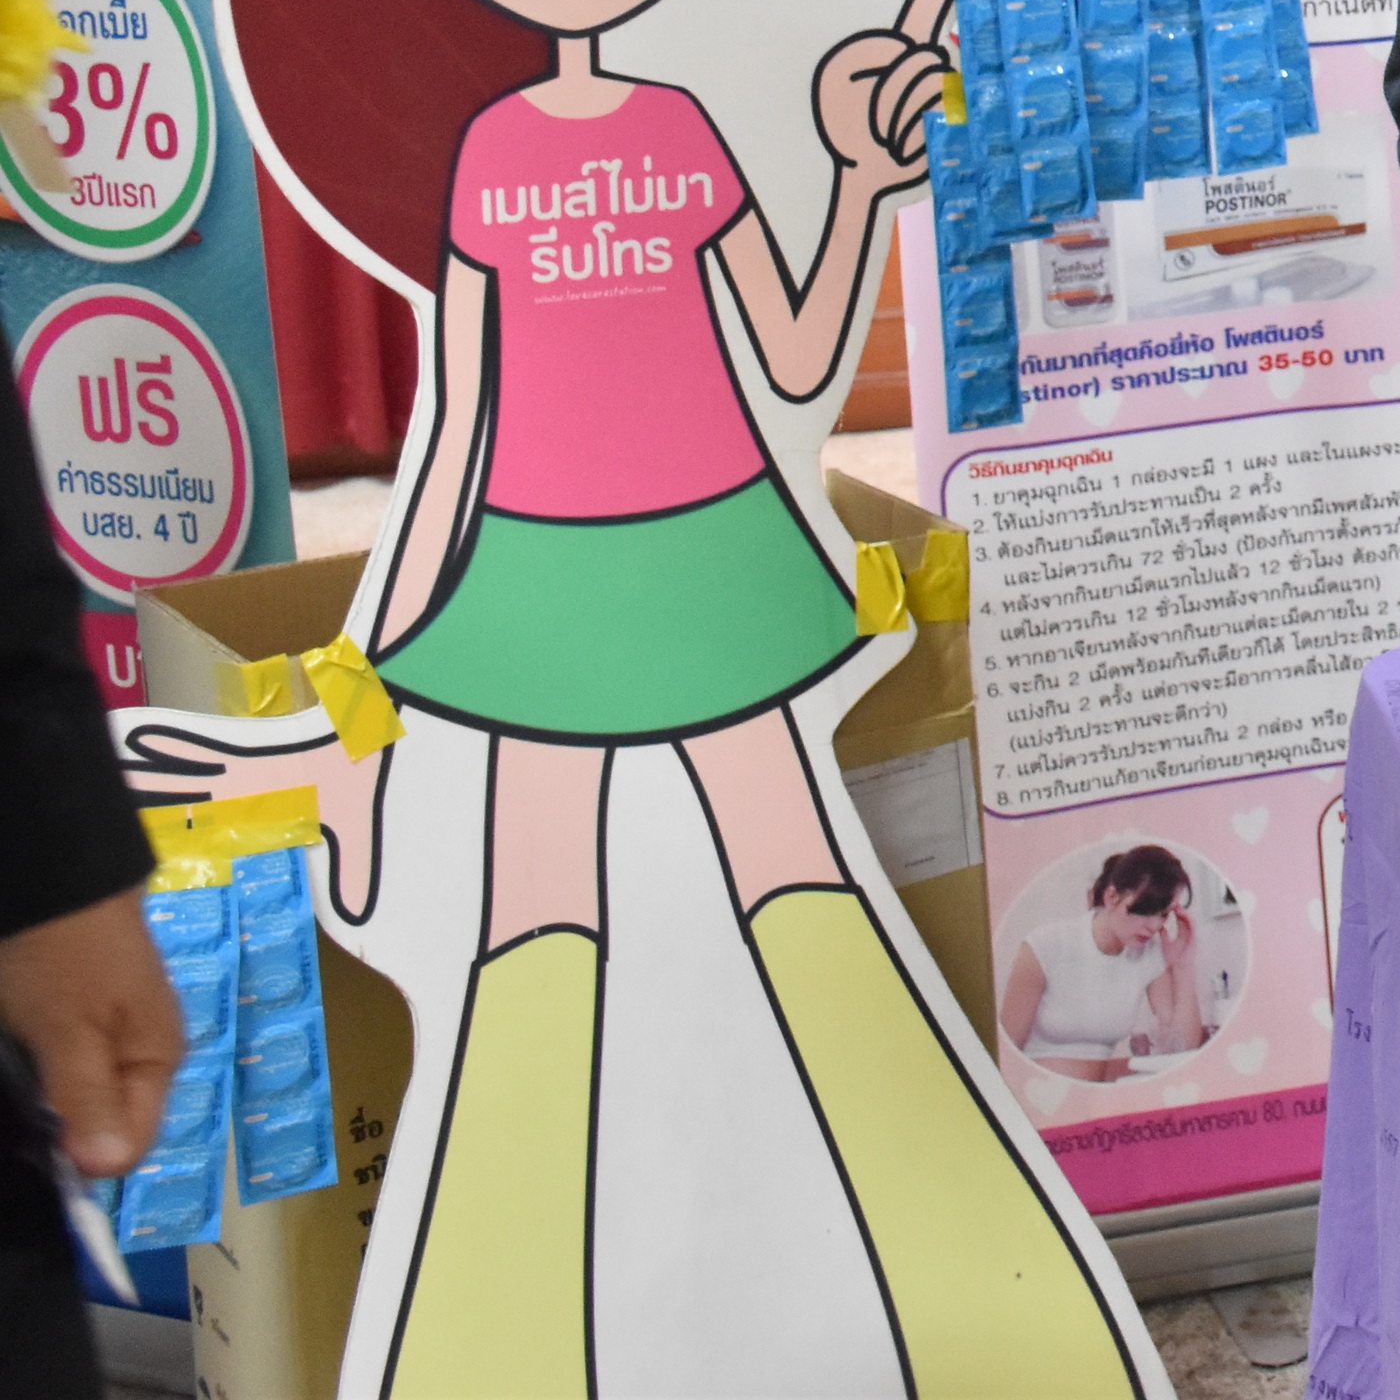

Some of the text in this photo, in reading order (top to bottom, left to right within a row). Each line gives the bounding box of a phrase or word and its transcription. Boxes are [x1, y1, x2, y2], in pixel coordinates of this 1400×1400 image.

[480, 154, 714, 226] เมนส์ไม่มา
[1204, 192, 1287, 214] POSTINOR
[528, 220, 674, 284] รีบโทร
[1224, 320, 1325, 350] โพสตินอร์
[1111, 359, 1249, 392] ราคาประมาณ
[1258, 348, 1334, 374] 35-50
[1344, 345, 1386, 367] บาท
[79, 354, 181, 447] ฟรี
[57, 460, 215, 504] ค่าธรรมเนียม
[968, 448, 1113, 480] วิธีกินยาคุมฉุกเฉิน
[972, 493, 987, 507] 1.
[993, 476, 1103, 507] ยาคุมฉุกเฉิน
[1131, 458, 1215, 486] กล่องจะมี
[1243, 453, 1278, 471] แผง
[83, 510, 199, 545] บสย. 4 ปี
[973, 472, 1282, 534] 2. ให้แบ่งการรับประทานเป็น 2 ครั้ง
[974, 546, 990, 562] 3.
[1003, 553, 1133, 587] และไม่ควรเกิน
[1141, 550, 1164, 566] 72
[1172, 540, 1228, 563] ชั่วโมง
[979, 550, 1344, 616] 4. หลังจากกินยาเม็ดแรกไปแล้ว 12 ชั่วโมง
[1000, 575, 1381, 643] แต่ไม่ควรเกิน 12 ชั่วโมงหลังจากกินเม็ดแรก)
[984, 598, 1389, 672] 5. หากอาเจียนหลังจากกินยาแต่ละเม็ดภายใน 2
[986, 683, 1003, 698] 6.
[1009, 673, 1059, 695] จะกิน
[1068, 670, 1080, 686] 2
[1089, 636, 1286, 684] เม็ดพร้อมกันทีเดียวก็ได้
[1007, 700, 1070, 724] แบ่งกิน
[1079, 696, 1090, 712] 2
[1099, 682, 1133, 708] ครั้ง
[1009, 702, 1228, 753] (แบ่งรับประทานจะดีกว่า)
[994, 708, 1348, 780] 7. แต่ไม่ควรรับประทานเกิน 2 กล่อง หรือ
[996, 791, 1012, 807] 8.
